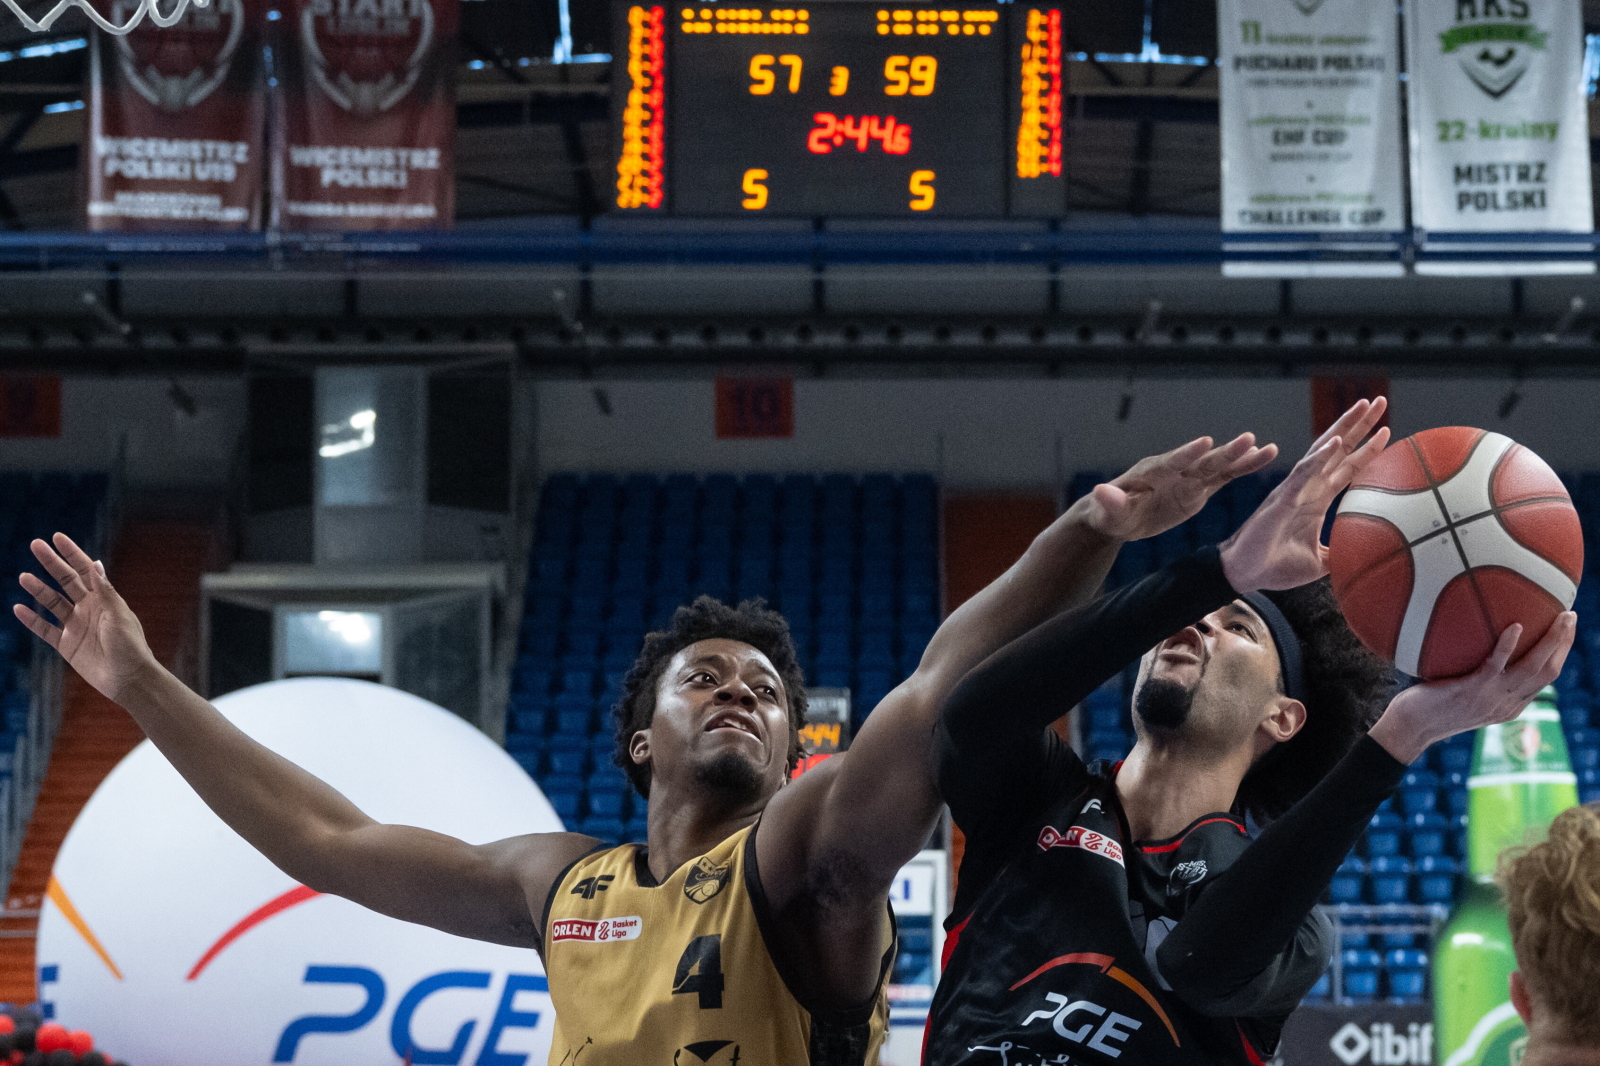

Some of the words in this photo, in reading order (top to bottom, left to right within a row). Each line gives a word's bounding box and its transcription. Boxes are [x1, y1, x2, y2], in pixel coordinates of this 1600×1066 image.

[749, 54, 803, 95] 57
[829, 65, 850, 96] 3
[884, 55, 938, 96] 59
[97, 135, 249, 163] WICEMISTRZ
[289, 146, 441, 170] WICEMISTRZ
[104, 158, 191, 181] POLSKI
[320, 168, 408, 188] POLSKI
[1454, 162, 1547, 184] MISTRZ
[742, 168, 769, 210] 5
[909, 169, 936, 211] 5
[1457, 190, 1547, 212] POLSKI
[571, 875, 615, 899] 4F
[553, 923, 592, 937] ORLEN
[611, 930, 627, 938] Liga
[612, 919, 637, 928] Basket
[672, 934, 725, 1009] 4
[272, 965, 550, 1066] PGE
[1021, 992, 1143, 1058] PGE
